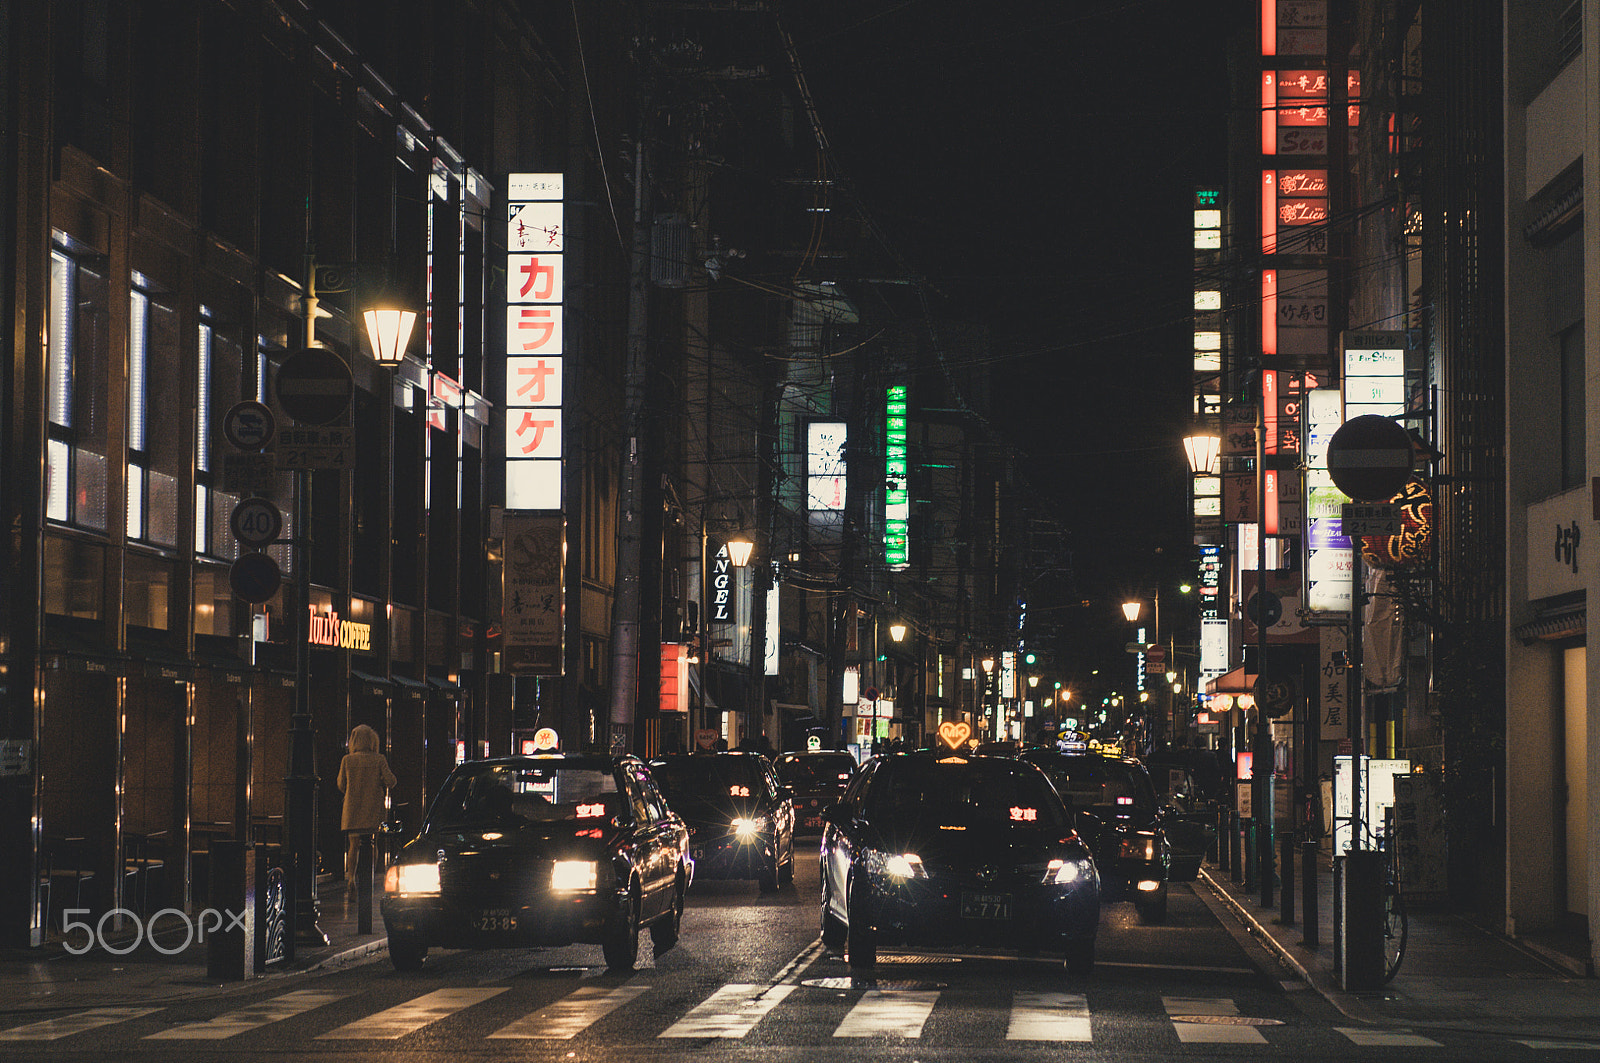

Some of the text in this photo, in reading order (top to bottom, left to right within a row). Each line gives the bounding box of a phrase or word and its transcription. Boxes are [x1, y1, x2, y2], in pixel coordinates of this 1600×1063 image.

[1265, 74, 1273, 85] 3
[1265, 173, 1273, 184] 2
[1297, 177, 1327, 192] Lien
[1297, 206, 1327, 221] Lien
[1280, 303, 1326, 322] 竹寿司
[517, 256, 556, 455] カラオケ
[242, 512, 270, 534] 40
[711, 543, 730, 620] ANGEL
[340, 620, 370, 651] COFFEE
[943, 727, 967, 739] MK
[576, 803, 605, 818] 空車
[1009, 806, 1037, 821] 空車
